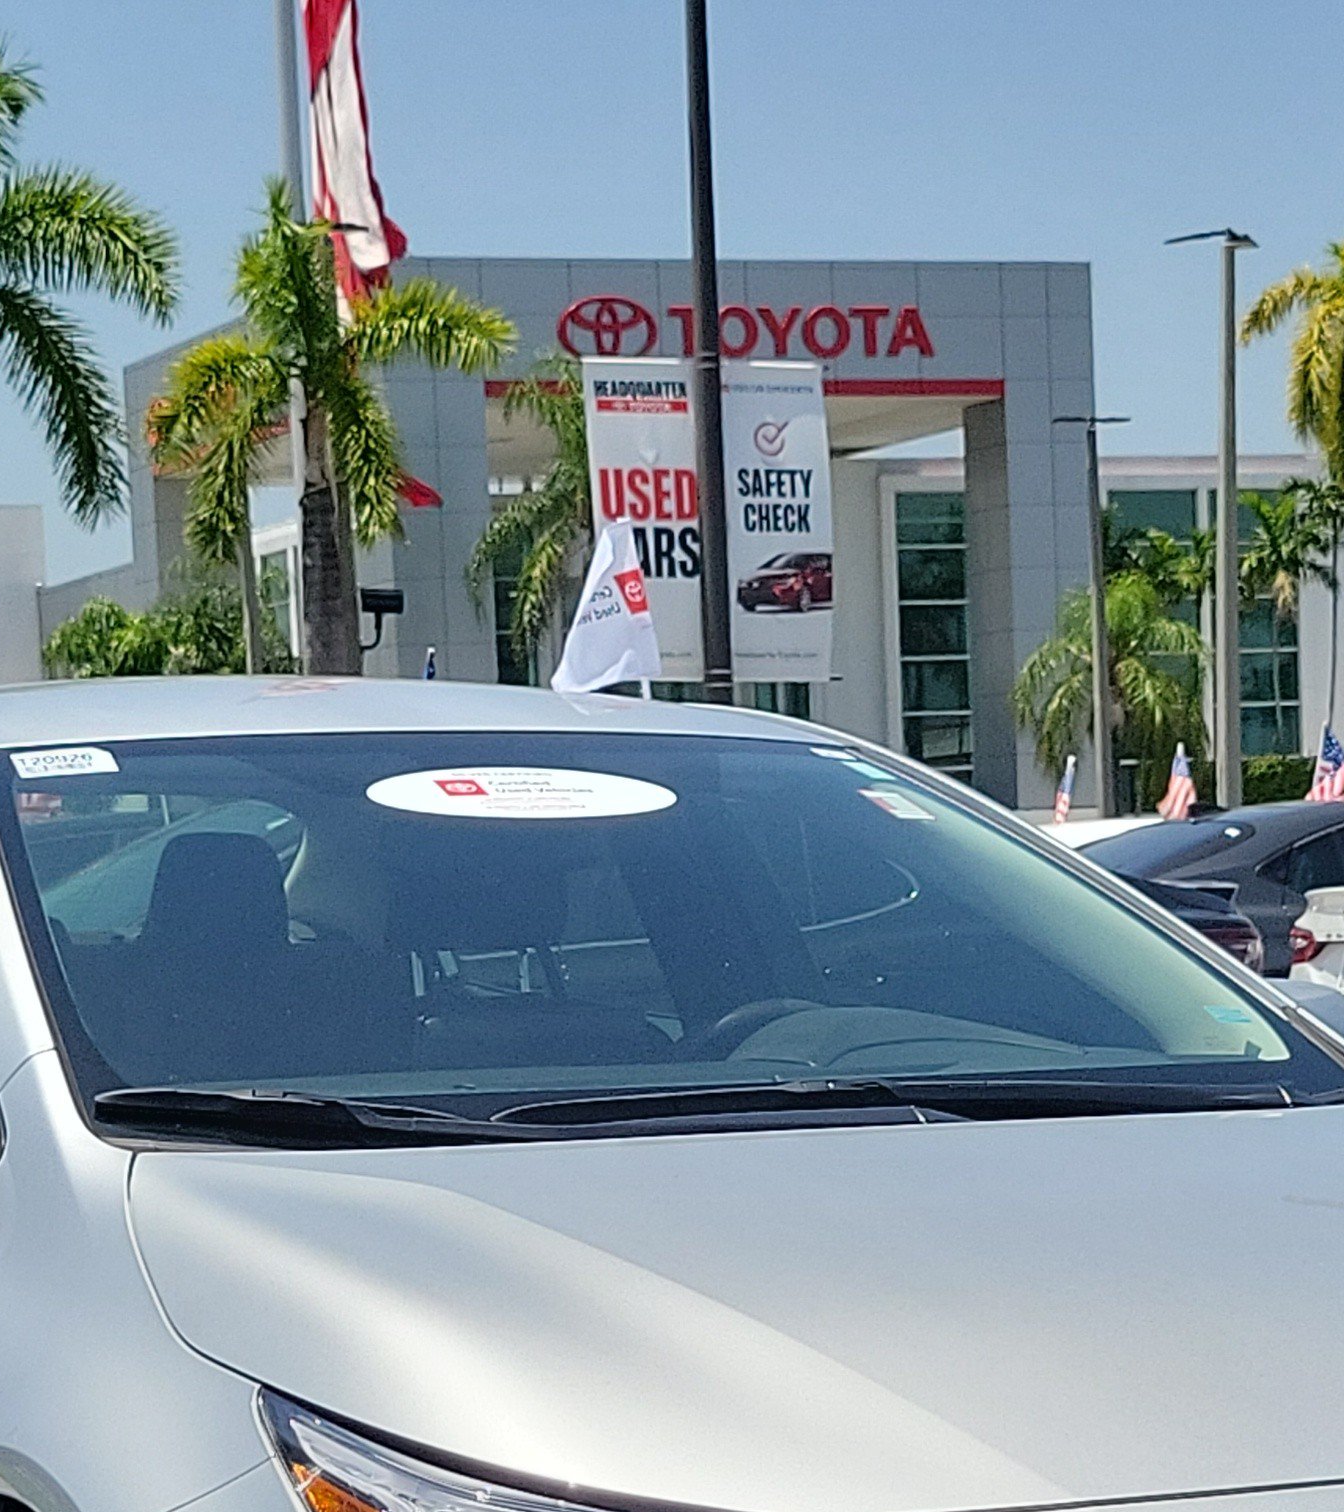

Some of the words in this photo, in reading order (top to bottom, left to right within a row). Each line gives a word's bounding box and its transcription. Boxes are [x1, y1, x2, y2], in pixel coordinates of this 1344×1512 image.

[668, 306, 935, 358] TOYOTA
[593, 380, 687, 399] HEADQUARTER
[599, 468, 697, 521] USED
[738, 468, 813, 499] SAFETY
[744, 503, 810, 533] CHECK
[633, 527, 700, 578] ARS
